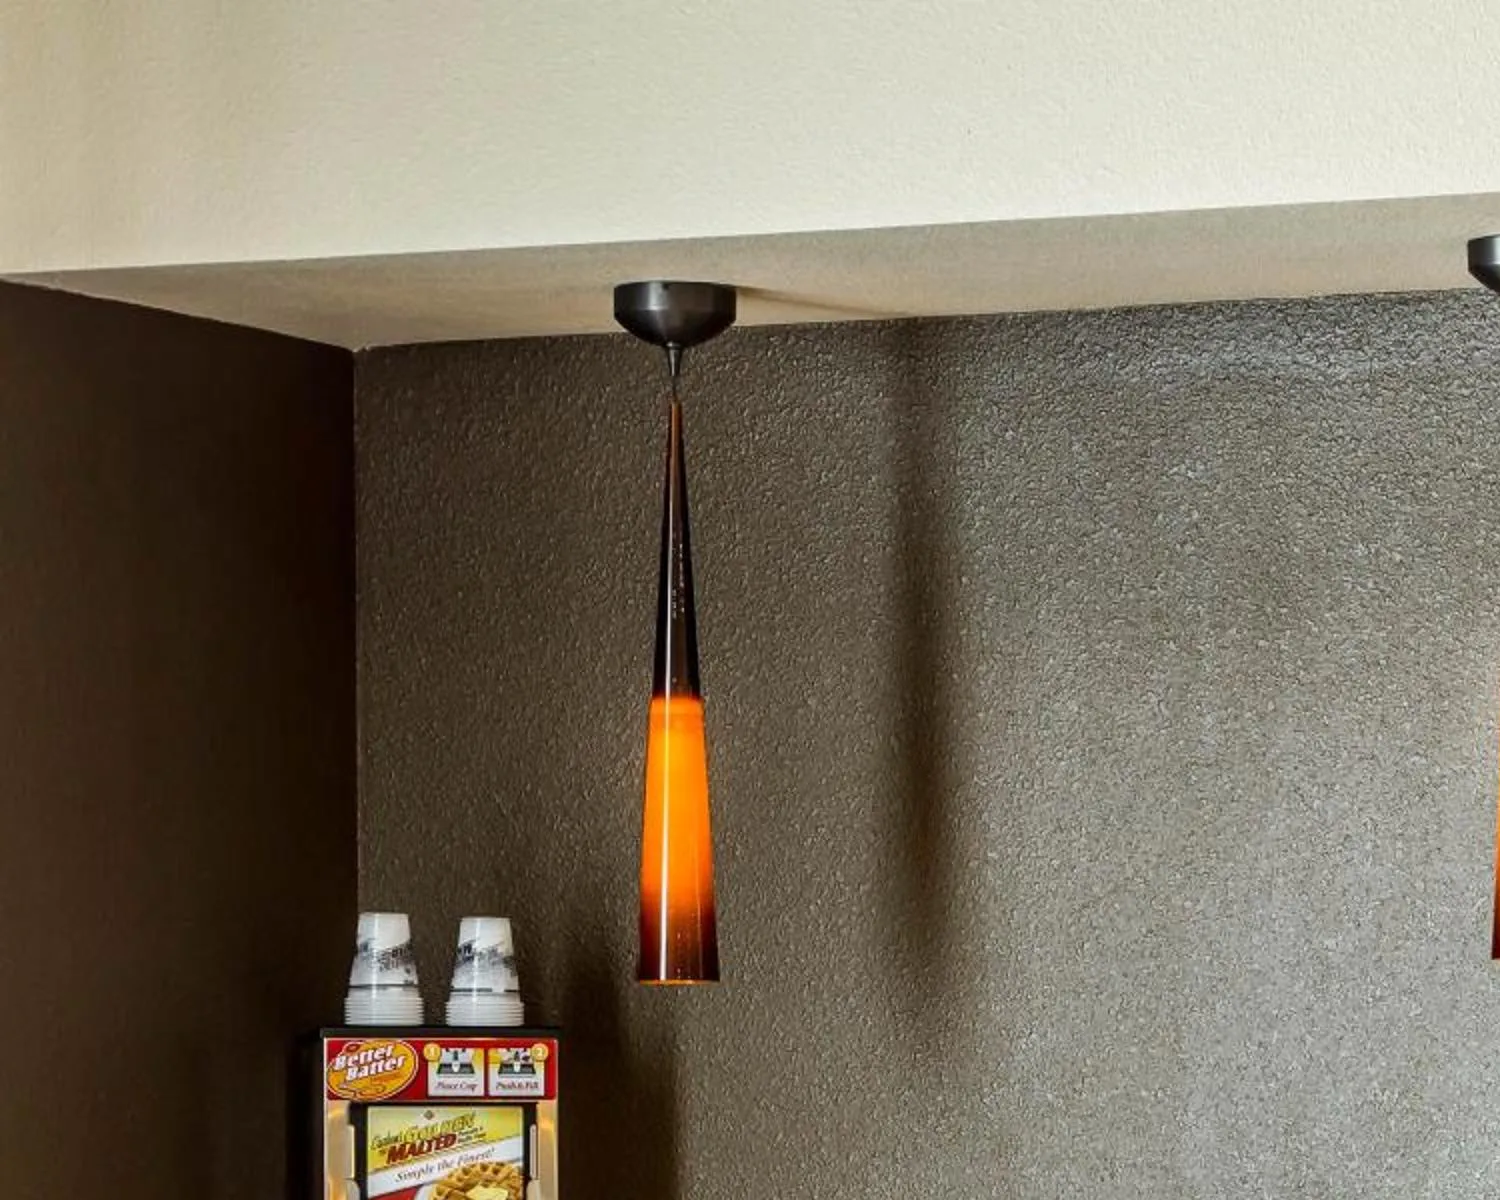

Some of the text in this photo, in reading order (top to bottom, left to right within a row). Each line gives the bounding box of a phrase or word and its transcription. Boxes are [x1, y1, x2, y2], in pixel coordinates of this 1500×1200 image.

[334, 1044, 394, 1071] Better
[345, 1055, 406, 1082] Batter
[385, 1133, 458, 1164] MALTED
